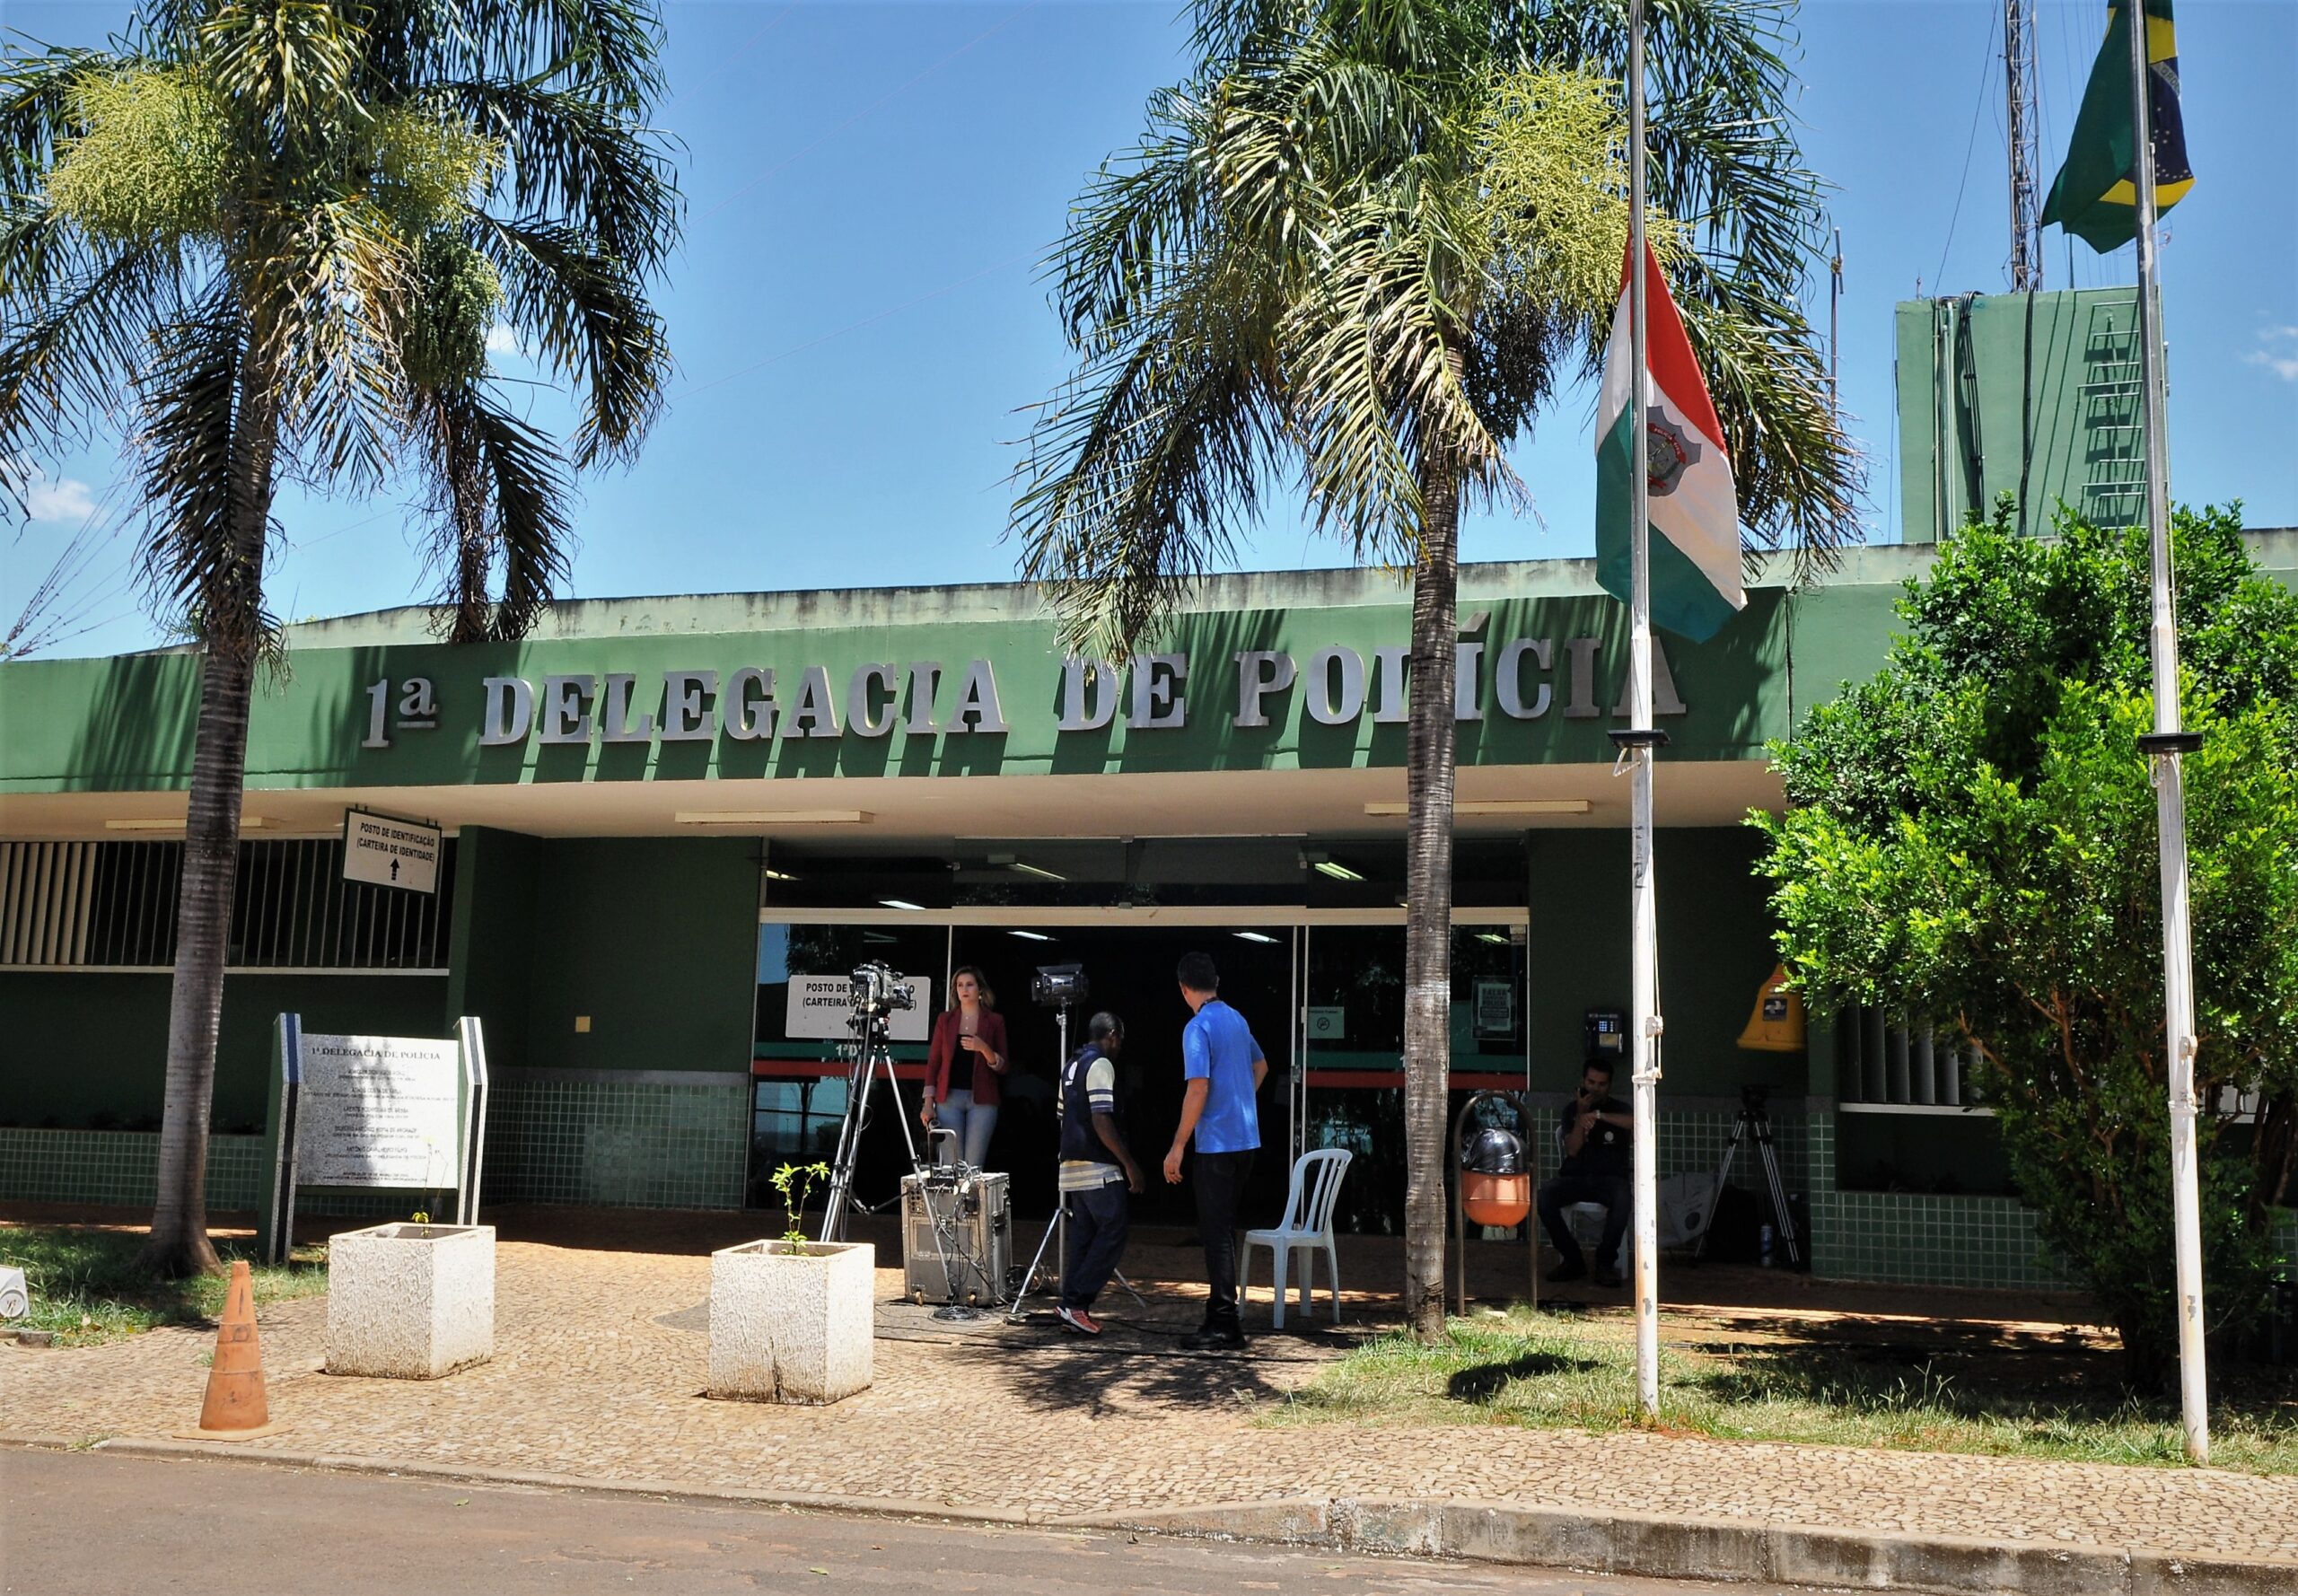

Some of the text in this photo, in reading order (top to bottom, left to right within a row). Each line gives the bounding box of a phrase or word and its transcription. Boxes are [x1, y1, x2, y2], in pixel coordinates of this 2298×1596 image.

[362, 677, 439, 748] 1ª
[478, 660, 1009, 746] DELEGACIA
[1057, 653, 1186, 731] DE
[360, 822, 434, 847] POSTO DE IDENTIFICAÇÃO
[357, 837, 434, 864] (CARTEIRA DE IDENTIDADE)
[806, 983, 847, 993] POSTO DE
[803, 997, 847, 1008] (CARTEIRA
[322, 1048, 382, 1057] DELEGACIA
[384, 1049, 398, 1058] DE
